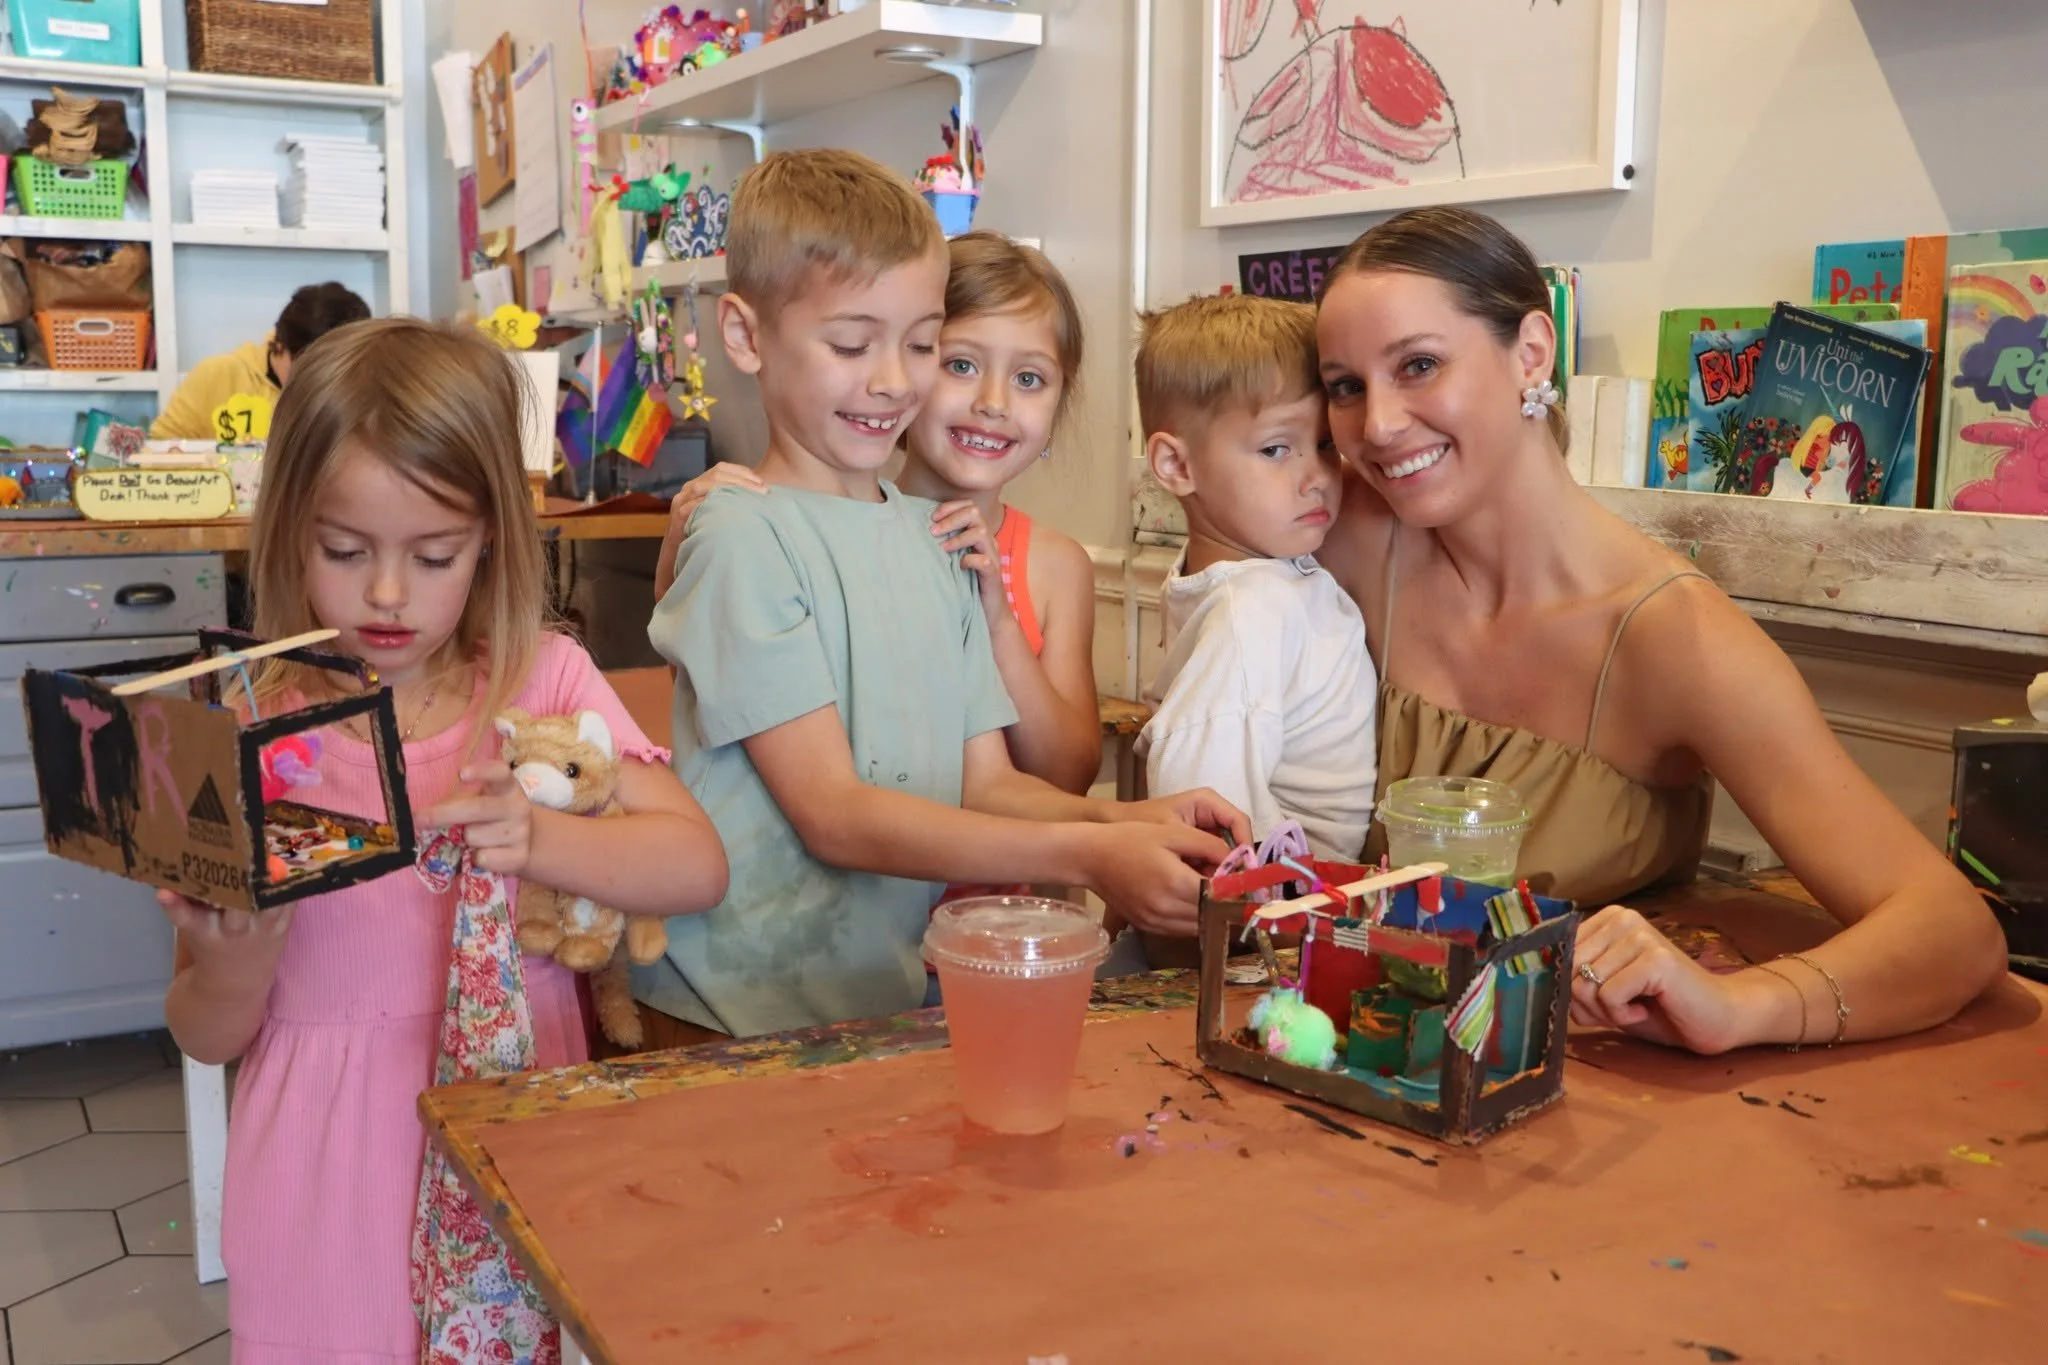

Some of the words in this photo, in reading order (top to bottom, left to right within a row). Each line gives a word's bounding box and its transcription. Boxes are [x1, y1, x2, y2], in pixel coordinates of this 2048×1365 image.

[1248, 255, 1341, 297] CREE
[1826, 337, 1850, 361] Uni
[1775, 338, 1897, 408] UNICORN
[218, 408, 252, 442] $7
[82, 475, 114, 487] Please
[147, 475, 161, 485] Go
[165, 473, 198, 487] Behind
[199, 475, 220, 485] Art
[135, 489, 169, 500] Thank
